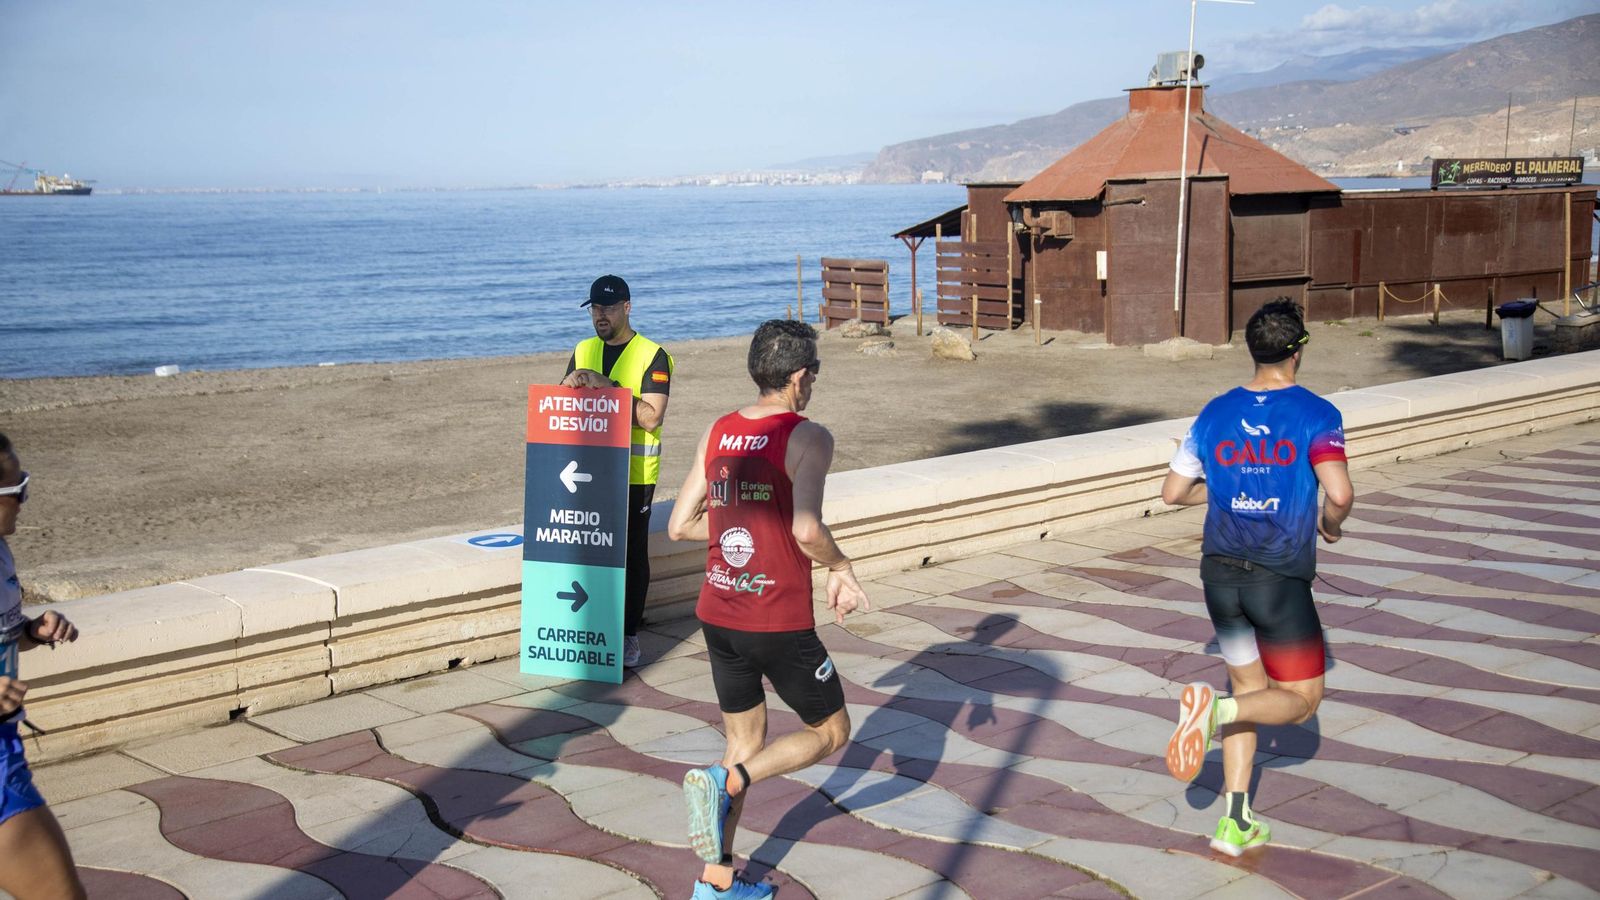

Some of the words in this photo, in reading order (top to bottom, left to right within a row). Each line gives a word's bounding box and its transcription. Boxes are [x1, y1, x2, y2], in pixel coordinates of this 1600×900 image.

[1463, 161, 1512, 174] MERENDERO
[1515, 162, 1527, 174] EL
[1529, 160, 1582, 174] PALMERAL
[539, 395, 619, 413] ¡ATENCIÓN
[549, 414, 608, 432] DESVÍO!
[719, 434, 769, 451] MATEO
[1215, 439, 1297, 466] GALO
[741, 492, 751, 500] del
[753, 491, 770, 500] BIO
[550, 509, 600, 525] MEDIO
[536, 527, 613, 547] MARATÓN
[538, 627, 607, 646] CARRERA
[528, 645, 615, 667] SALUDABLE
